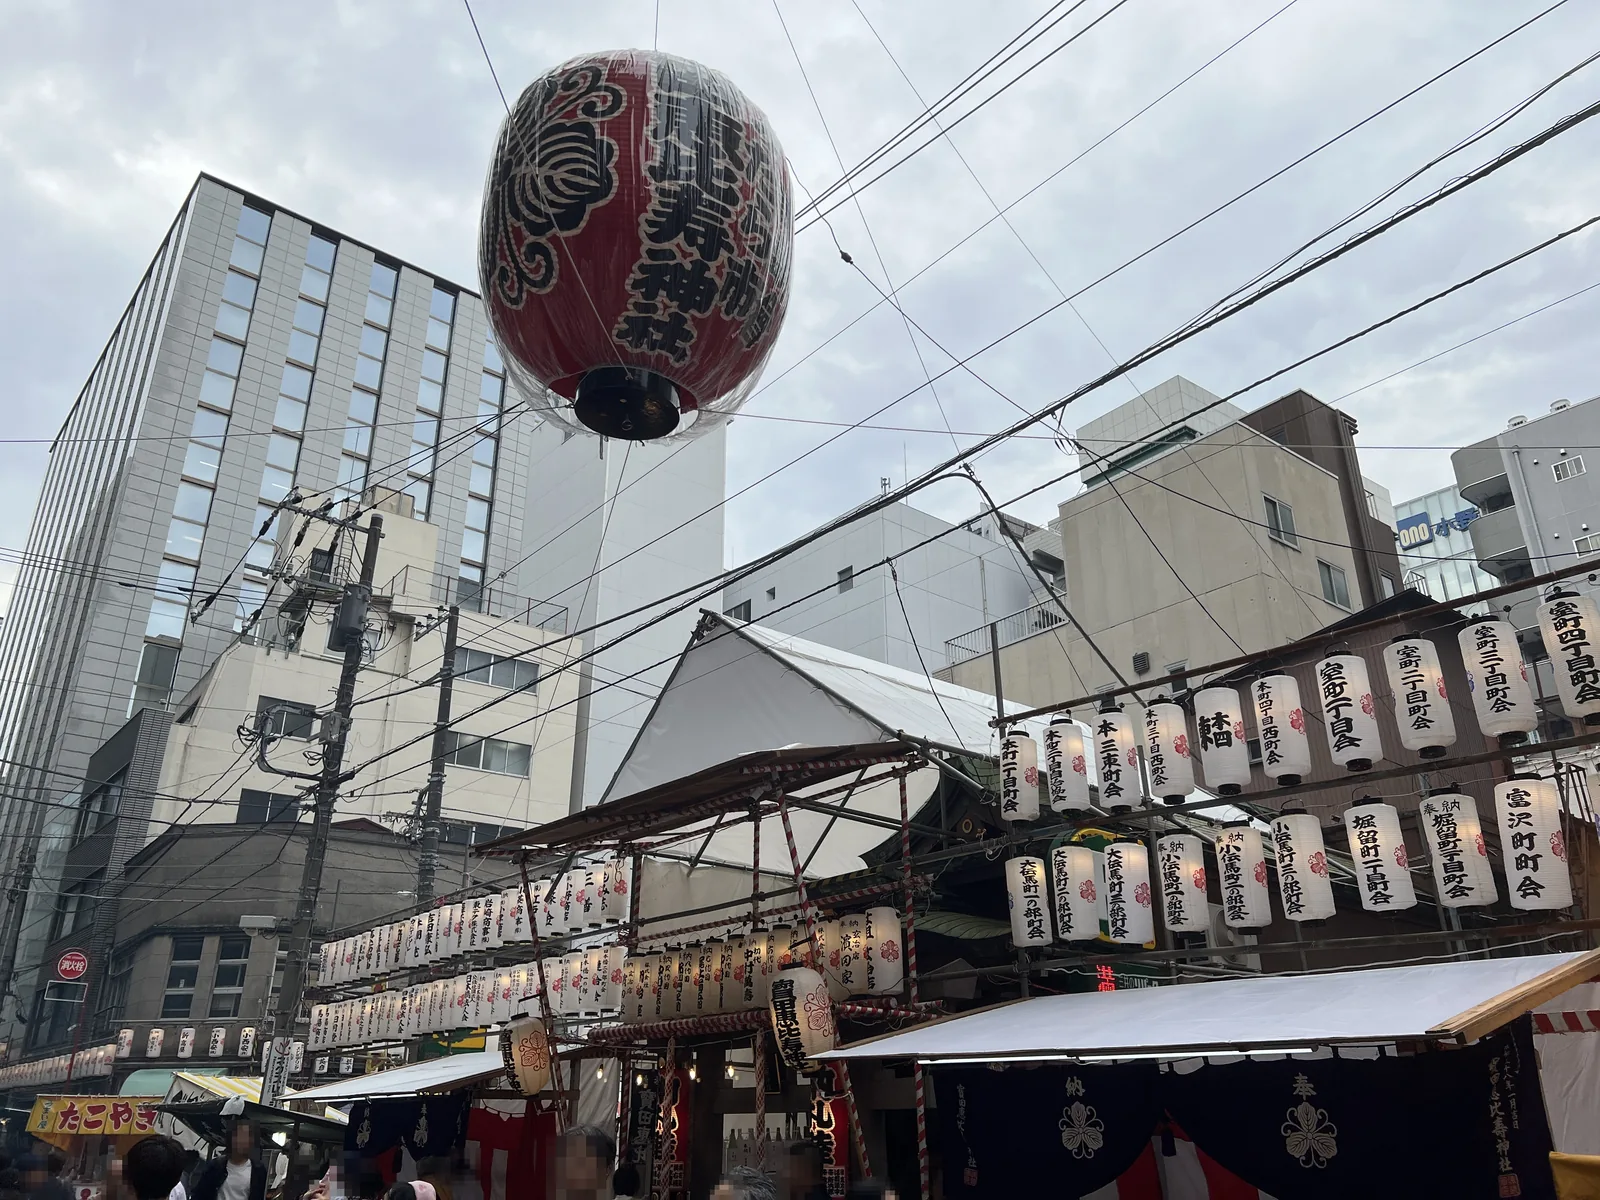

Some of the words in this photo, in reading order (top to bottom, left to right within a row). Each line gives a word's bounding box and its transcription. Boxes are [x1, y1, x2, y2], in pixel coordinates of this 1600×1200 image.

[1400, 523, 1429, 547] ono
[1396, 645, 1435, 730] 室町二丁目町会
[1474, 626, 1517, 713] 室町三丁目町会
[1549, 602, 1600, 704] 室町四丁目町会
[1145, 709, 1169, 786] 本町三丁目西町会
[1256, 682, 1284, 765] 本町四丁目西町会
[1319, 662, 1363, 752] 室町一丁目会
[1001, 739, 1020, 813] 本町一丁目町会
[1424, 799, 1461, 817] 奉納
[1219, 844, 1250, 921] 小伝馬町二の部町会
[1273, 822, 1305, 915] 小伝馬町三の部町会
[1351, 814, 1394, 906] 堀留町一丁目町会
[1432, 813, 1475, 899] 堀留町二丁目町会
[1506, 788, 1546, 899] 富沢町町会
[1019, 859, 1046, 940] 大伝馬町一の部町会
[1053, 850, 1075, 935] 大伝馬町二の部町会
[1106, 848, 1130, 939] 大伝馬町三の部町会
[1161, 854, 1189, 925] 小伝馬町一の部町会
[61, 960, 85, 972] 消火栓
[58, 1101, 157, 1132] たこやき
[1066, 1076, 1086, 1097] 納
[1292, 1073, 1317, 1101] 奉
